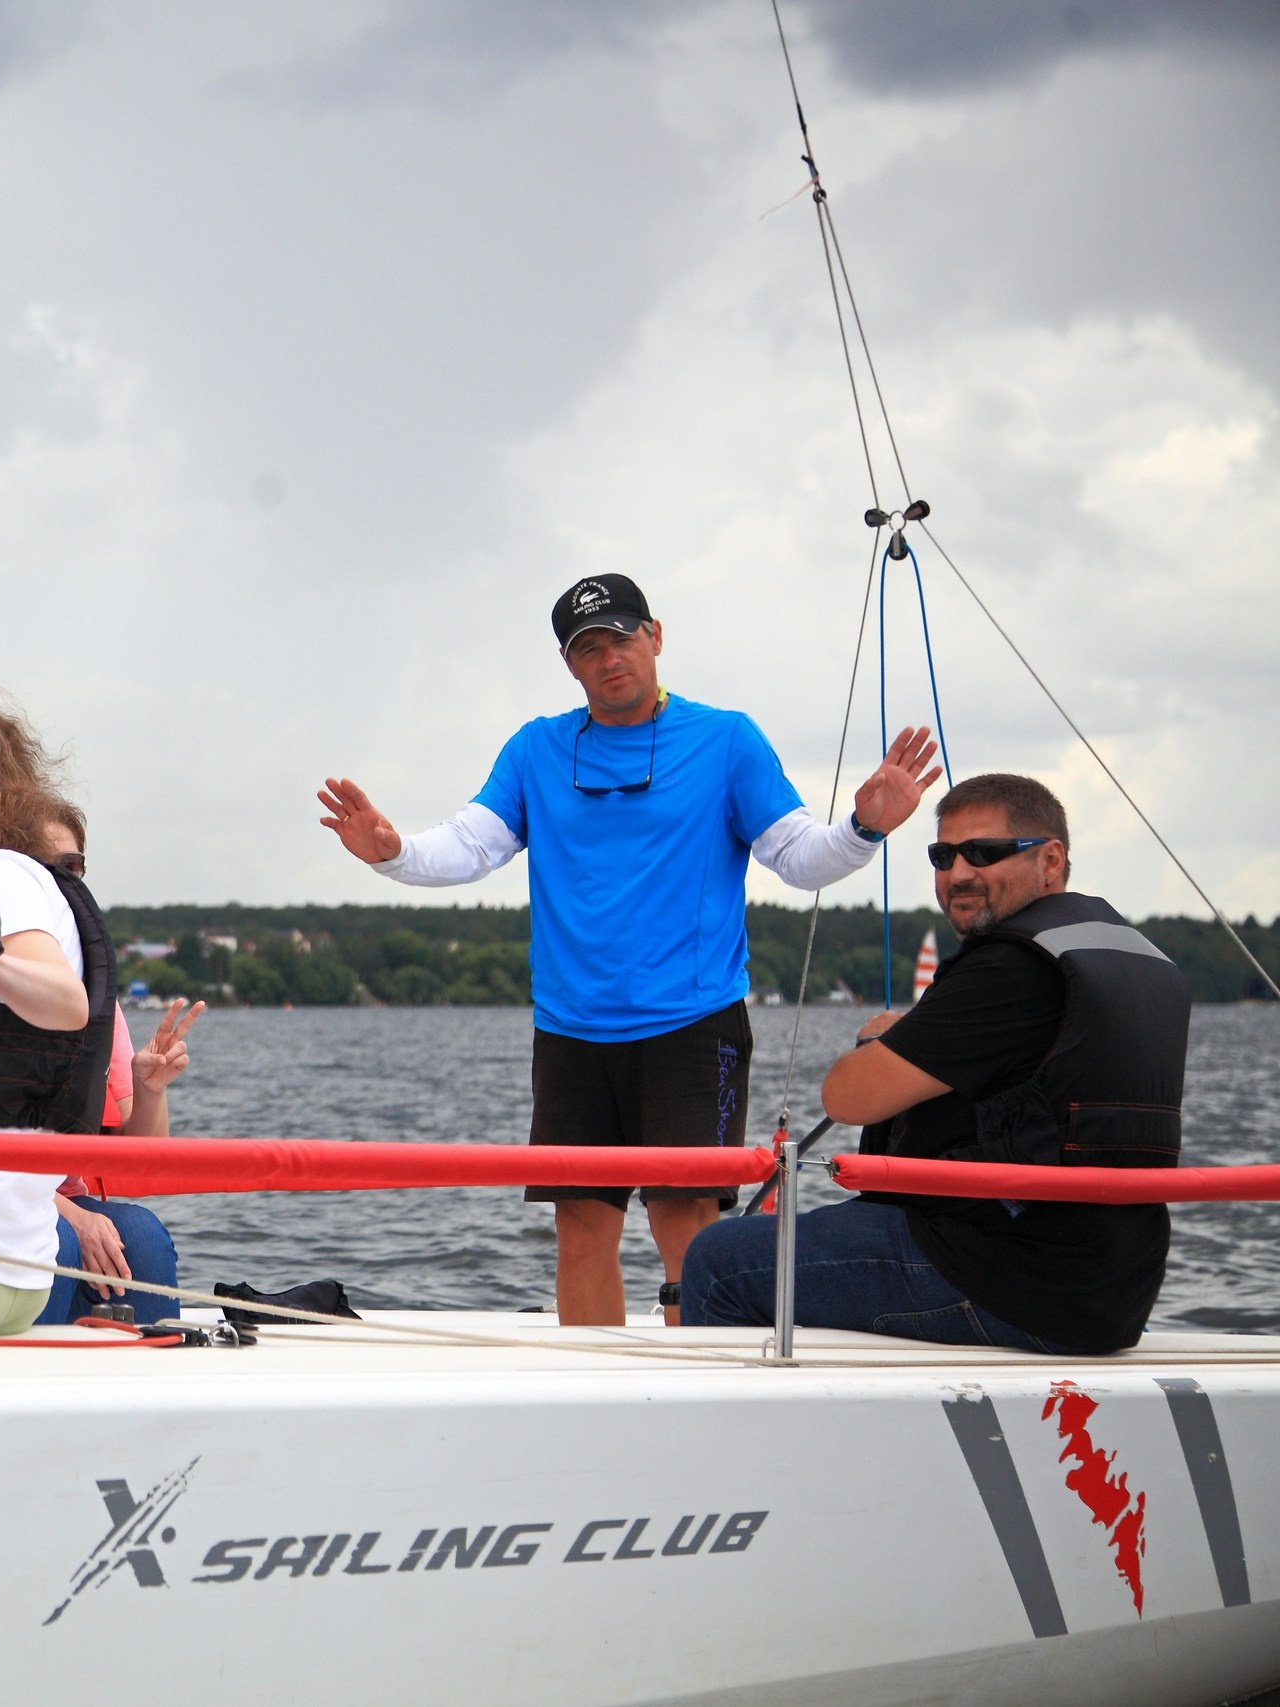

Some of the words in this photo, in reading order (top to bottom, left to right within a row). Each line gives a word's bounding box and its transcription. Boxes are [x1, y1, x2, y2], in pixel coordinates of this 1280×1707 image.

[590, 581, 609, 595] FRANCE
[574, 603, 594, 615] SAILING
[585, 606, 599, 614] 1933
[192, 1521, 554, 1584] SAILING
[562, 1509, 770, 1564] CLUB
